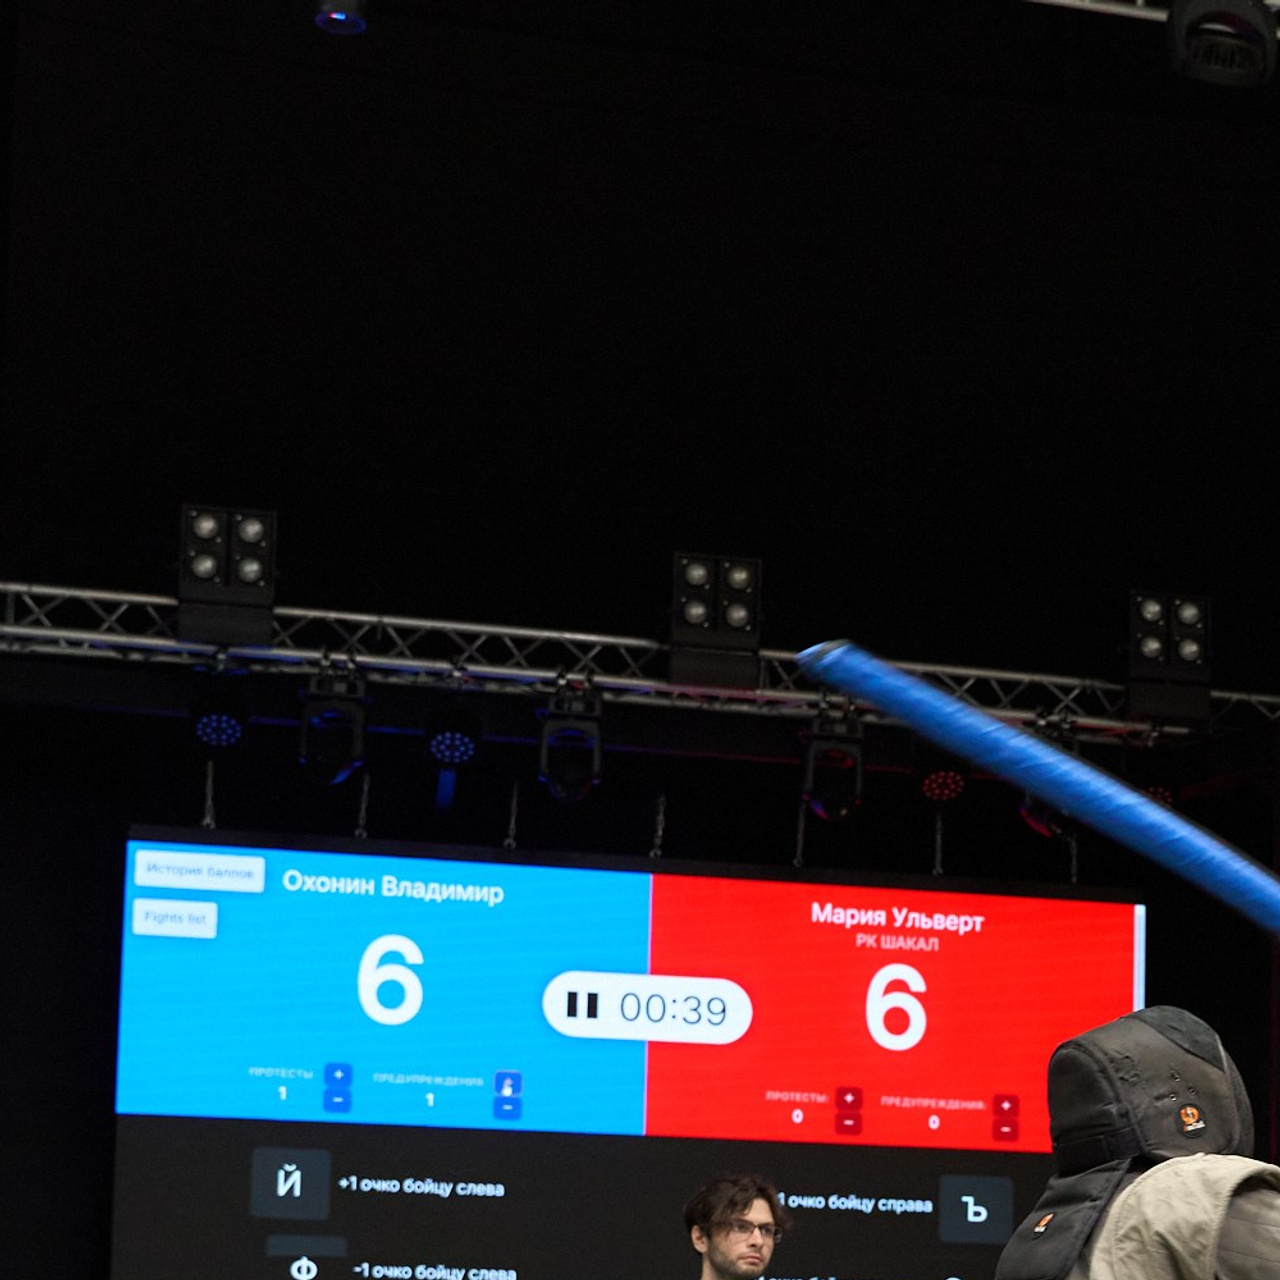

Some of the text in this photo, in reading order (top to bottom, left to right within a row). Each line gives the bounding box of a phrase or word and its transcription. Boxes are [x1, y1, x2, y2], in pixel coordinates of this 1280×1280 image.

[146, 863, 254, 880] История баллов
[281, 869, 505, 907] Охонин Владимир
[144, 910, 207, 926] Fights list
[811, 901, 984, 933] Мария Ульверт
[855, 933, 940, 952] РК ШАКАЛ
[357, 933, 425, 1026] 6
[619, 992, 727, 1027] 00:39
[865, 962, 928, 1052] 6
[278, 1085, 288, 1101] 1
[425, 1092, 435, 1108] 1
[791, 1108, 804, 1124] 0
[928, 1114, 941, 1130] 0
[276, 1163, 302, 1198] Й
[338, 1175, 505, 1198] +1 очко бойцу слева
[788, 1195, 825, 1209] очко
[828, 1195, 875, 1213] бойцу
[878, 1198, 933, 1215] справа
[961, 1195, 988, 1223] Ъ
[354, 1263, 370, 1278] -1
[372, 1264, 412, 1280] очко
